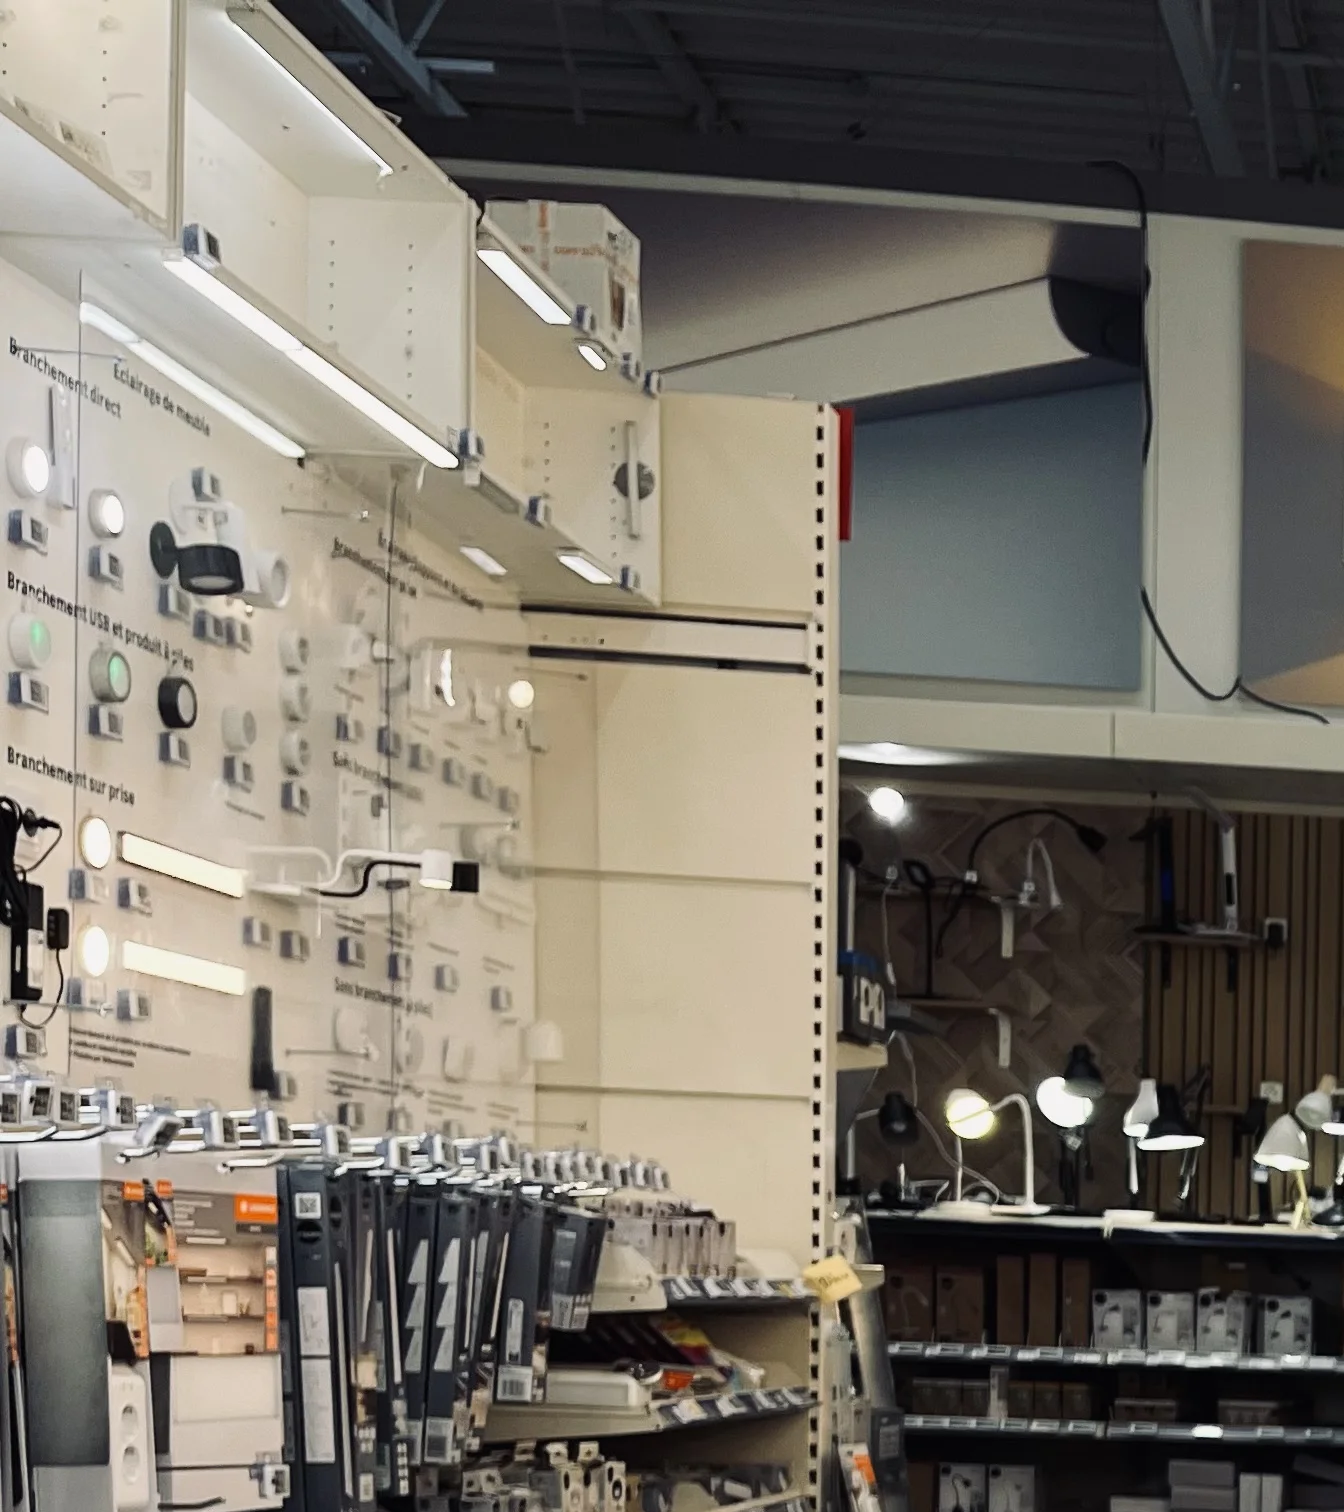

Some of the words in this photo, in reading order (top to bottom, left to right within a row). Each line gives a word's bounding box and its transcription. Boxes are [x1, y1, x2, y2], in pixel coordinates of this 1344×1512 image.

[90, 384, 122, 419] direct
[7, 570, 88, 624] Branchement
[112, 621, 124, 640] et
[7, 745, 87, 789] Branchement
[108, 783, 136, 807] prise
